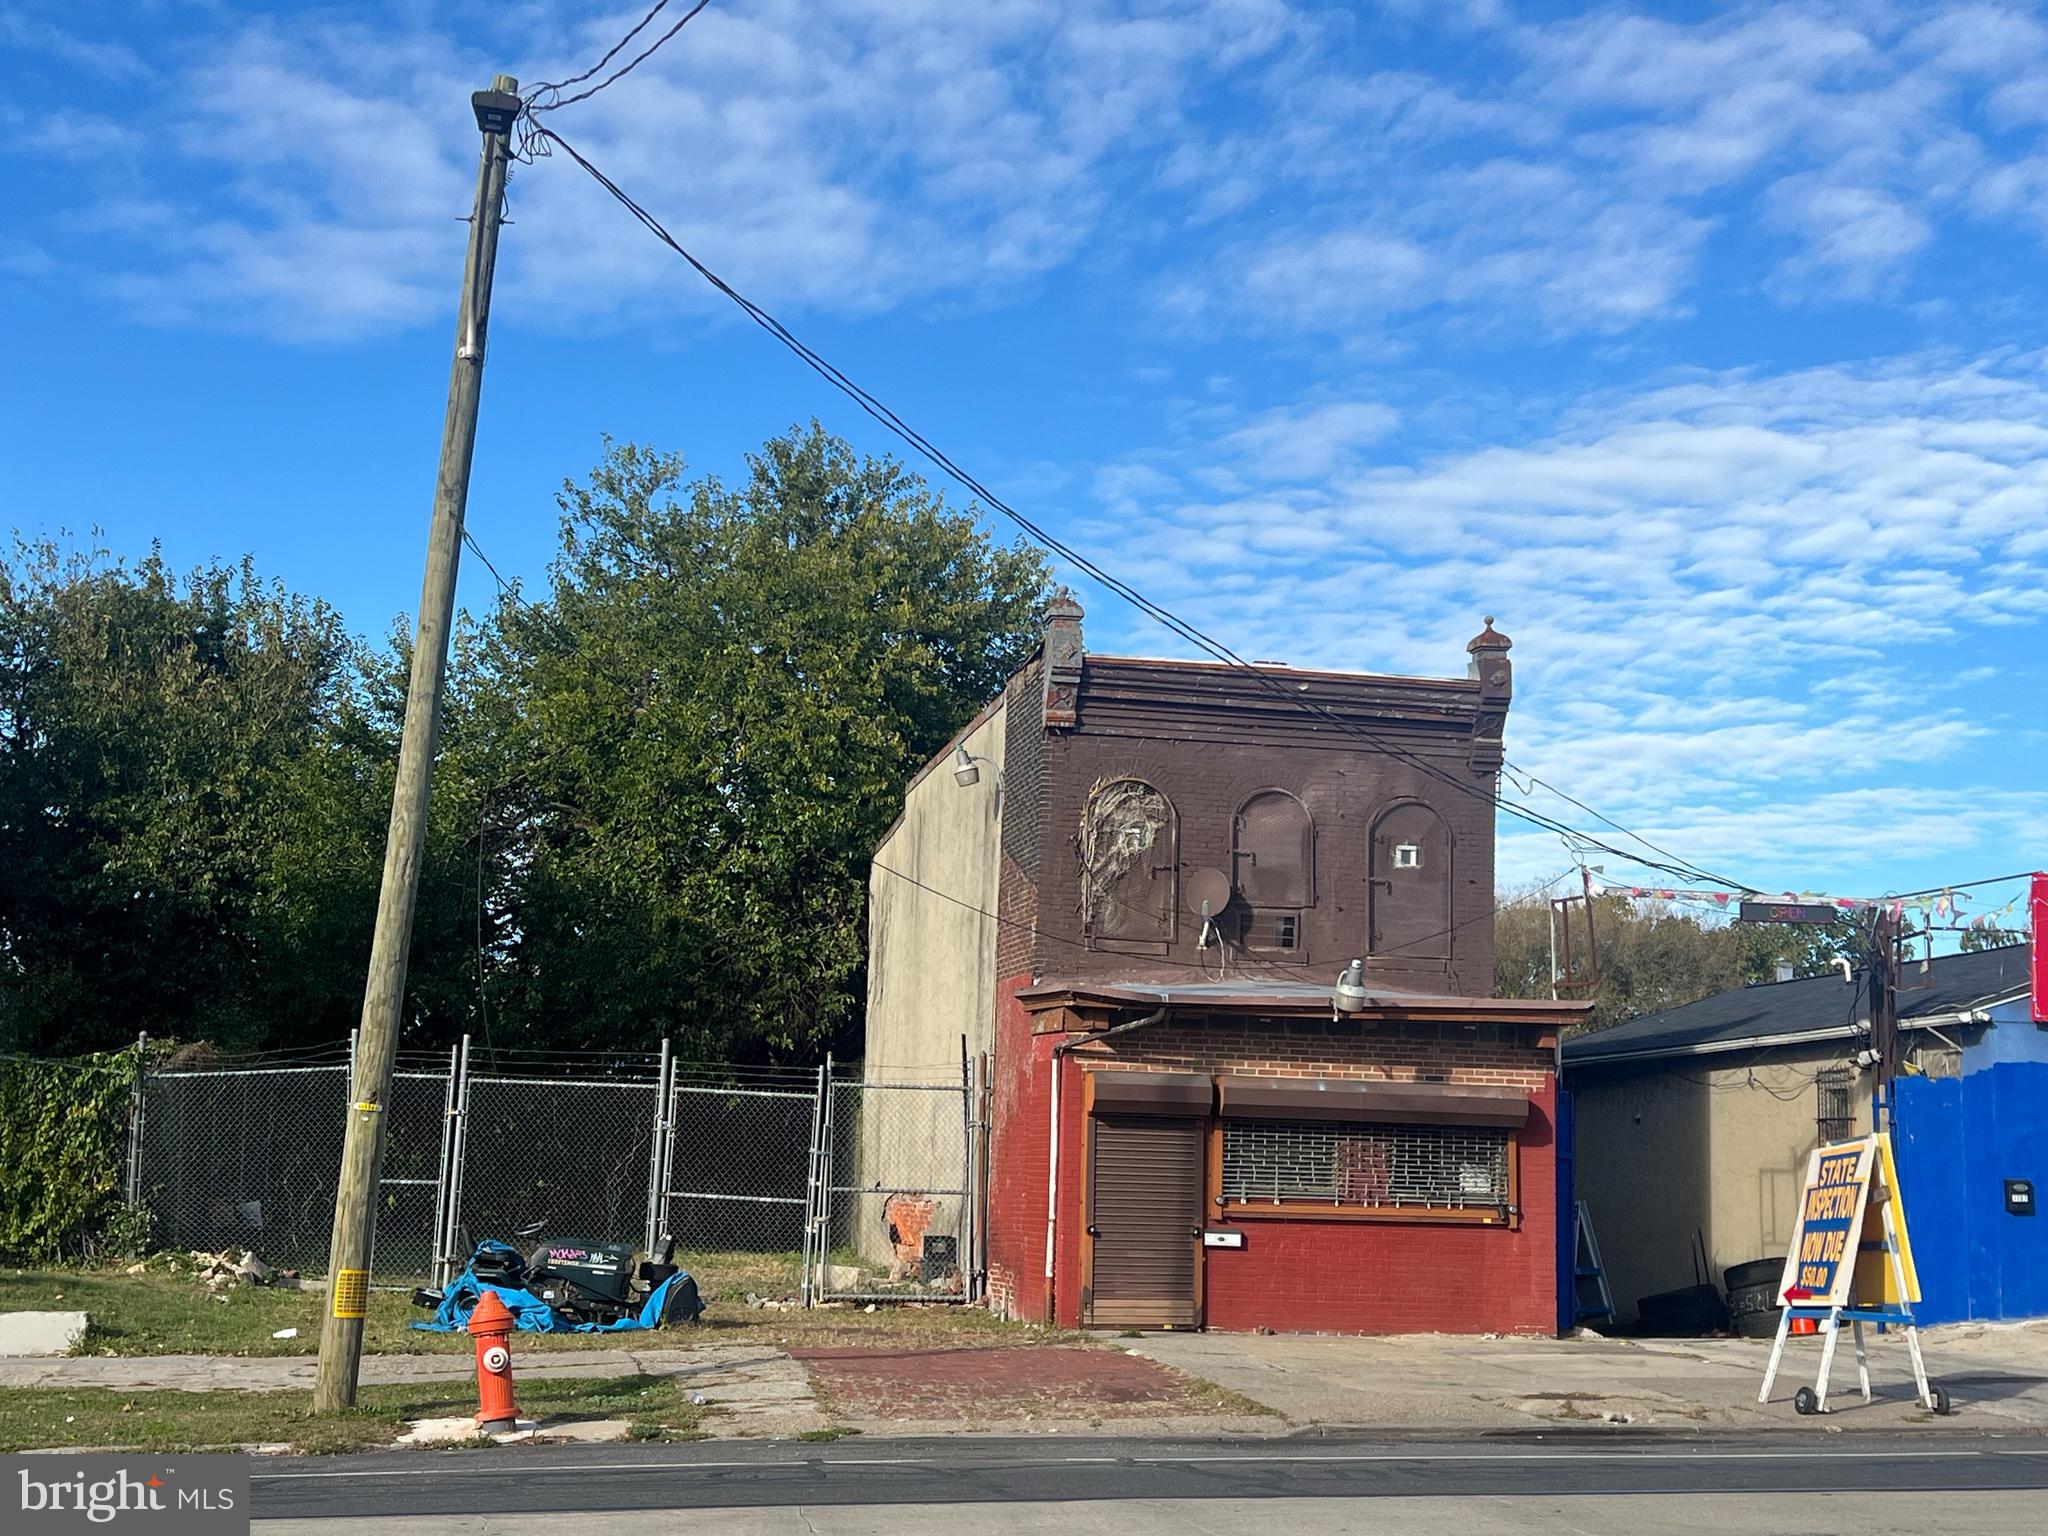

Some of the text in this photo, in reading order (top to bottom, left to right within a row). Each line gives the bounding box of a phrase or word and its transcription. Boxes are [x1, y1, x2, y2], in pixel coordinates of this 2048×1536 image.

[1769, 906, 1808, 919] OPEN
[1819, 1156, 1857, 1187] STATE
[1805, 1185, 1858, 1221] INSPECTION
[1800, 1231, 1846, 1263] NOW DUE
